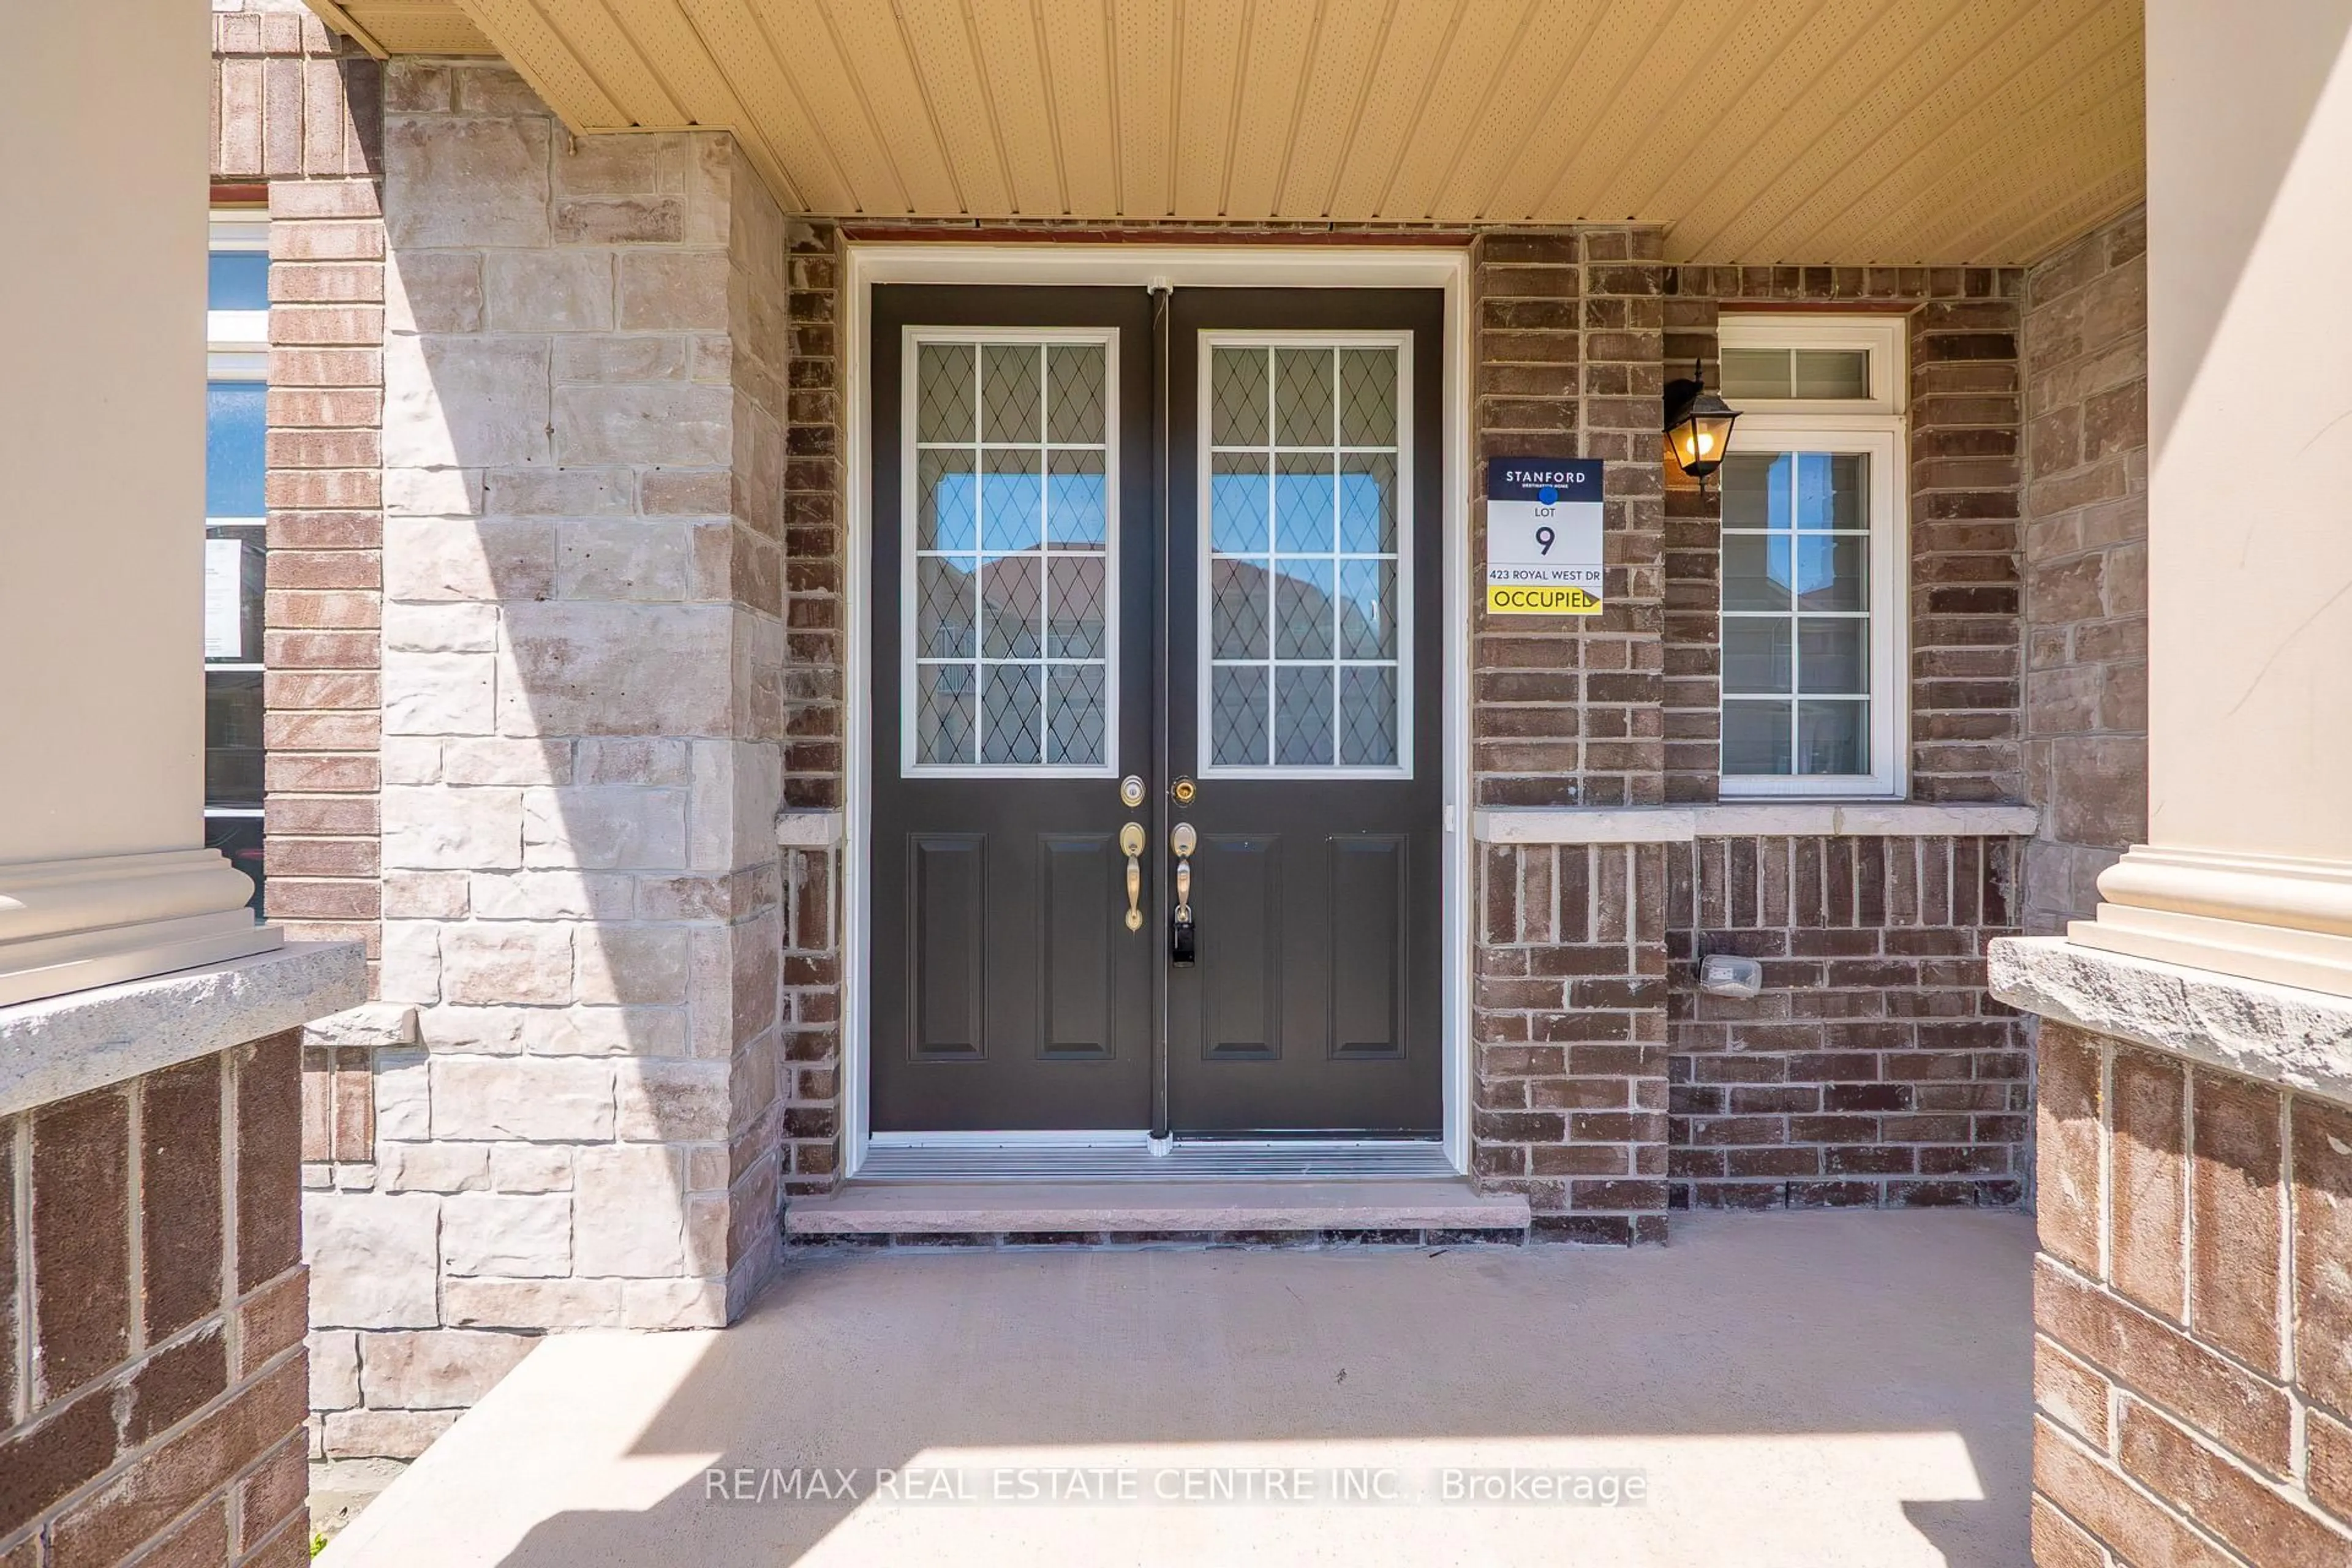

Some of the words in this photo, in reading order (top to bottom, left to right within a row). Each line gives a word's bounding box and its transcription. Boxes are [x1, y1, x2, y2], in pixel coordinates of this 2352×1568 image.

[1506, 471, 1585, 483] STANFORD
[1535, 508, 1555, 517] LOT
[1536, 526, 1555, 556] 9
[1490, 570, 1509, 579] 423
[1513, 570, 1548, 580] ROYAL
[1552, 571, 1582, 581] WEST
[1586, 571, 1600, 581] DR
